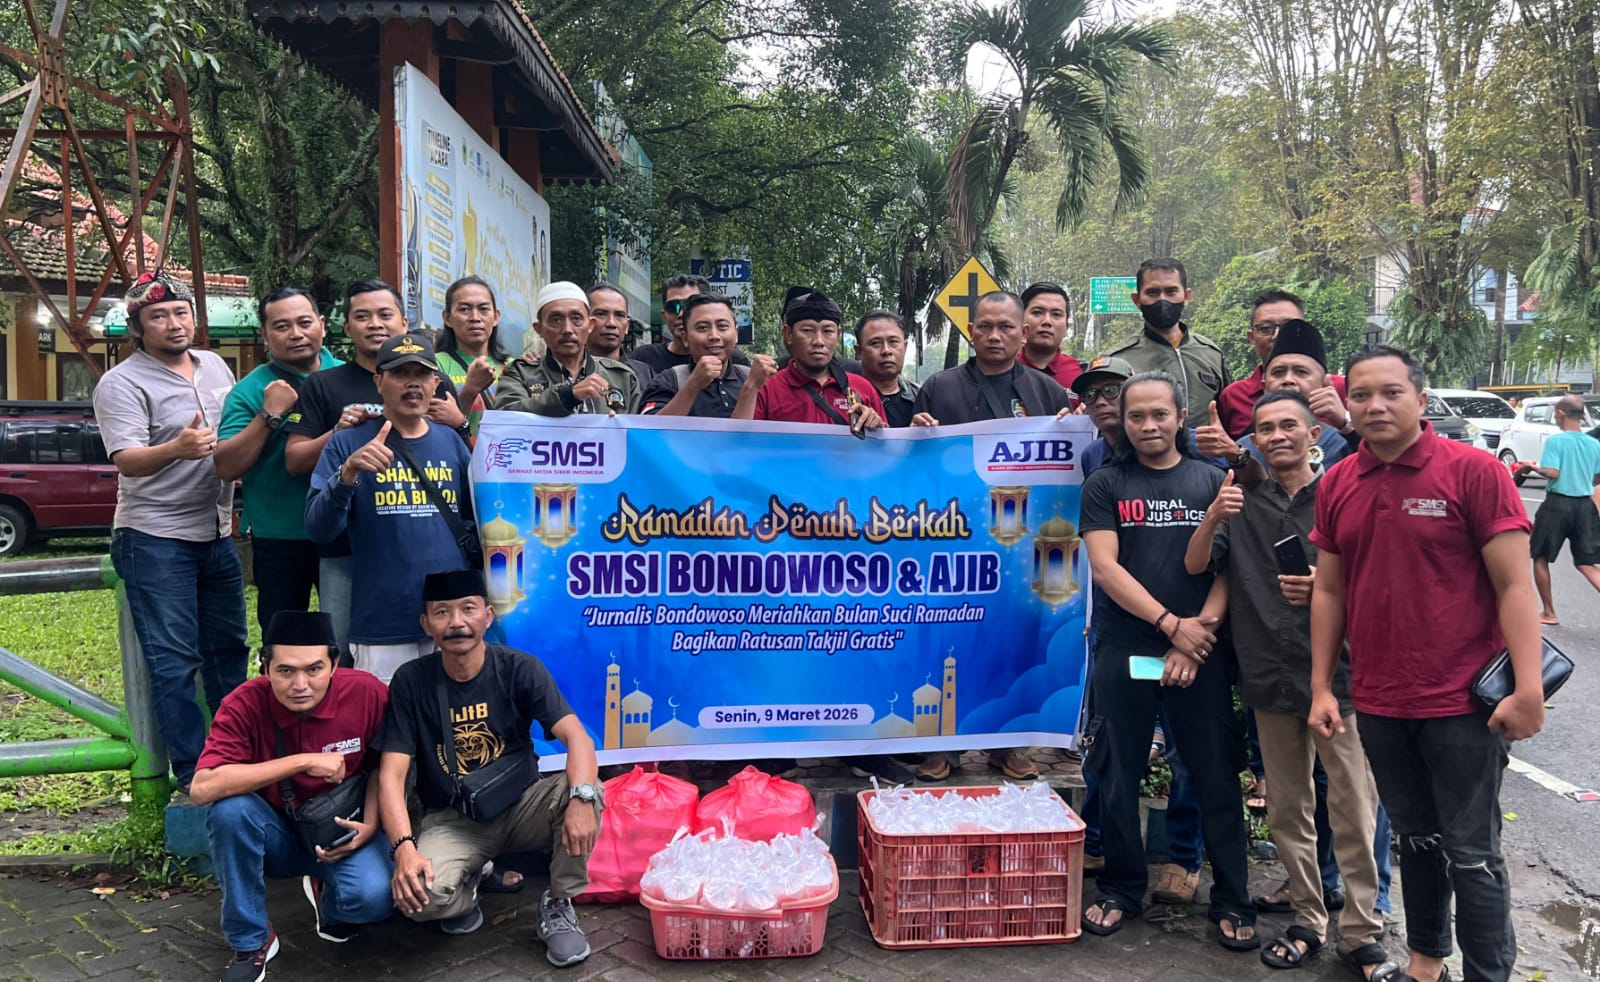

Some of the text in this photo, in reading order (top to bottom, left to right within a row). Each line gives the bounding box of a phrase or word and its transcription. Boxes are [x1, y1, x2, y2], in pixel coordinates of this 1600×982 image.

[427, 129, 450, 152] TIMELINE
[531, 440, 605, 467] SMSI
[988, 439, 1074, 463] AJIB
[375, 489, 408, 506] DOA
[1118, 499, 1187, 522] NO VIRAL
[569, 553, 998, 596] SMSI BONDOWOSO & AJIB
[655, 604, 745, 624] Bondowoso
[747, 605, 831, 624] Meriahkan
[834, 605, 879, 623] Bulan
[881, 605, 913, 623] Suci
[915, 603, 985, 623] Ramadan
[672, 631, 737, 655] Bagikan
[740, 632, 804, 650] Ratusan
[807, 632, 848, 654] Takjil
[715, 708, 858, 724] Senin, 9 Maret 2026
